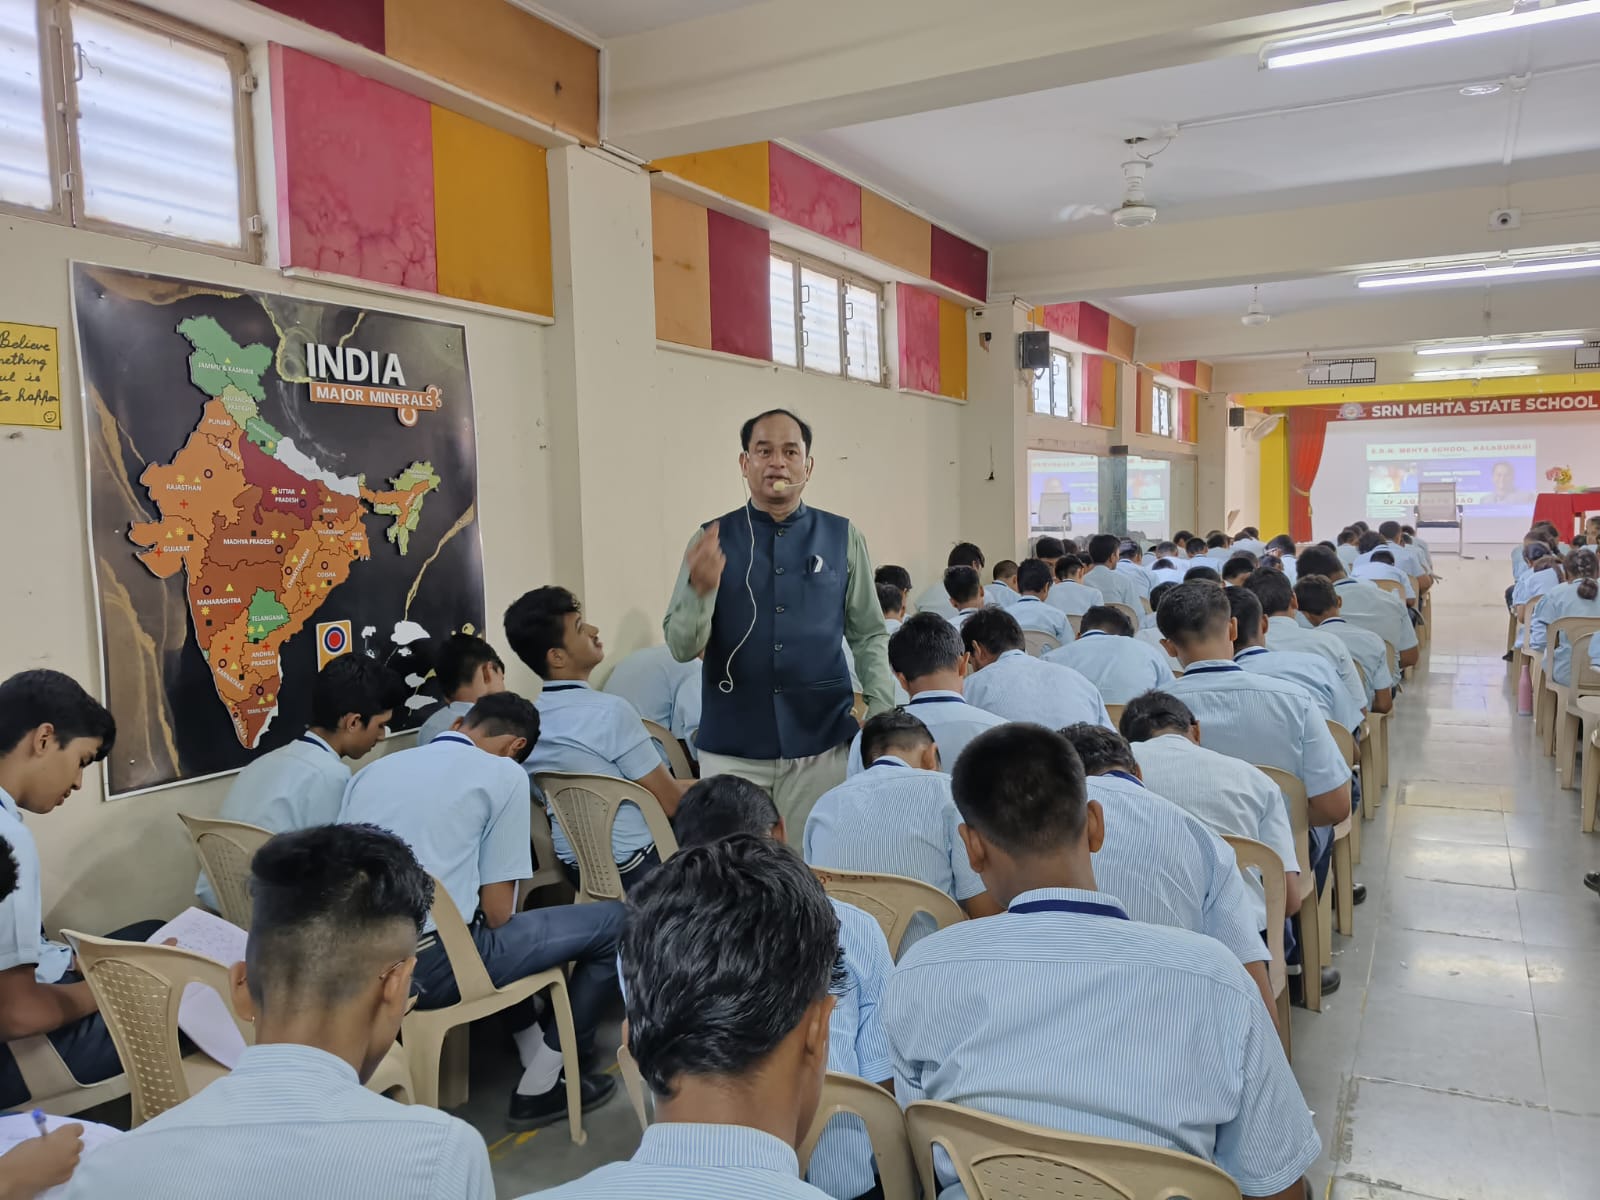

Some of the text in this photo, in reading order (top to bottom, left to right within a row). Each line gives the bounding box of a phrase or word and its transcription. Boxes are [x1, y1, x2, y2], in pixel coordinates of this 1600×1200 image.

[306, 342, 407, 386] INDIA
[316, 386, 433, 407] MAJOR MINERALS
[1371, 395, 1599, 417] SRN MEHTA STATE SCHOOL
[166, 483, 202, 491] RAJASTHAN
[163, 545, 190, 553] GUJARAT
[196, 597, 242, 606] MAHARASHTRA
[251, 614, 285, 622] TELANGANA
[251, 650, 276, 658] ANDHRA
[251, 659, 276, 667] PRADESH
